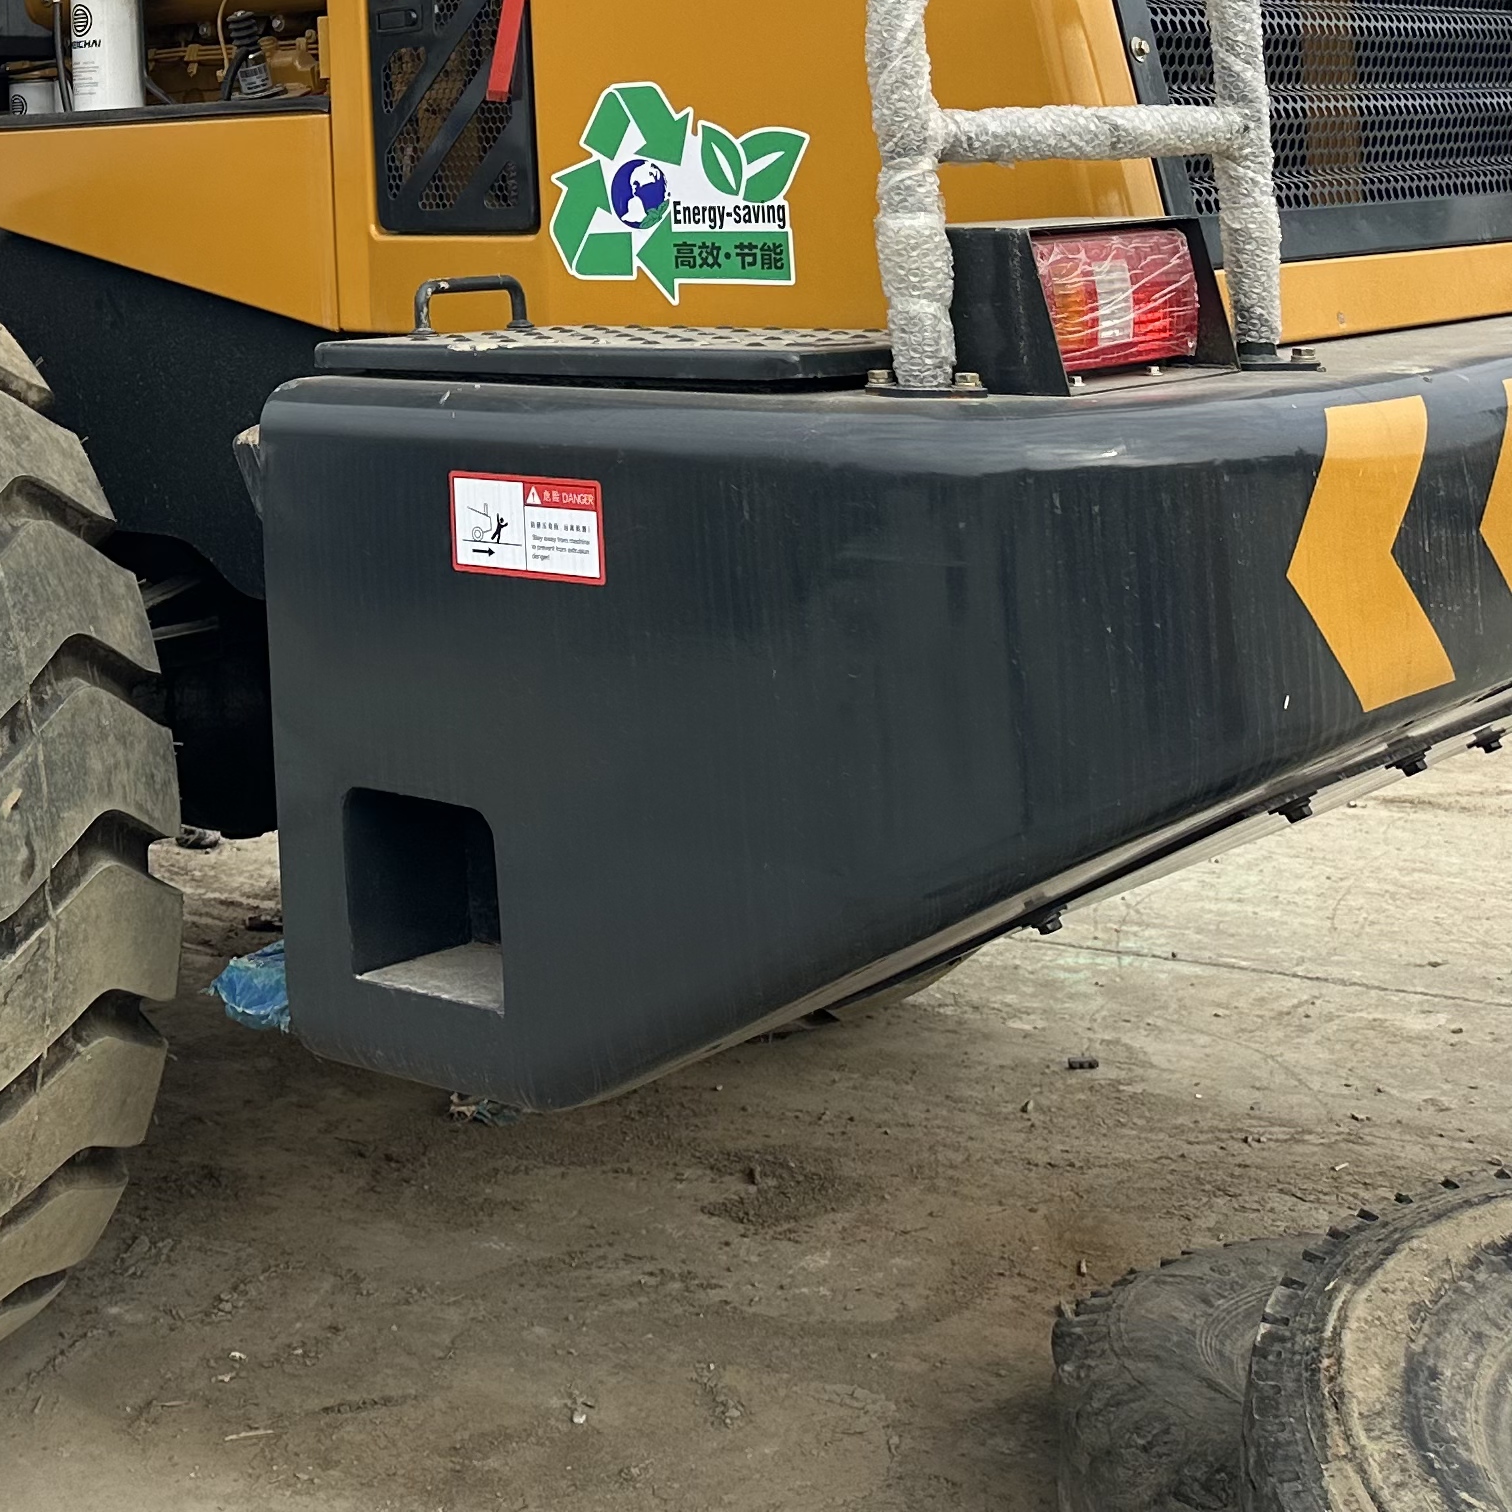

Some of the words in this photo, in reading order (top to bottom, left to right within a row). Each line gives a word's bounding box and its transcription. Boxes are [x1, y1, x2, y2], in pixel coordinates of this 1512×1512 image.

[672, 200, 786, 230] Energy-saving
[672, 241, 785, 271] 高效·节能
[562, 491, 595, 506] DANGER
